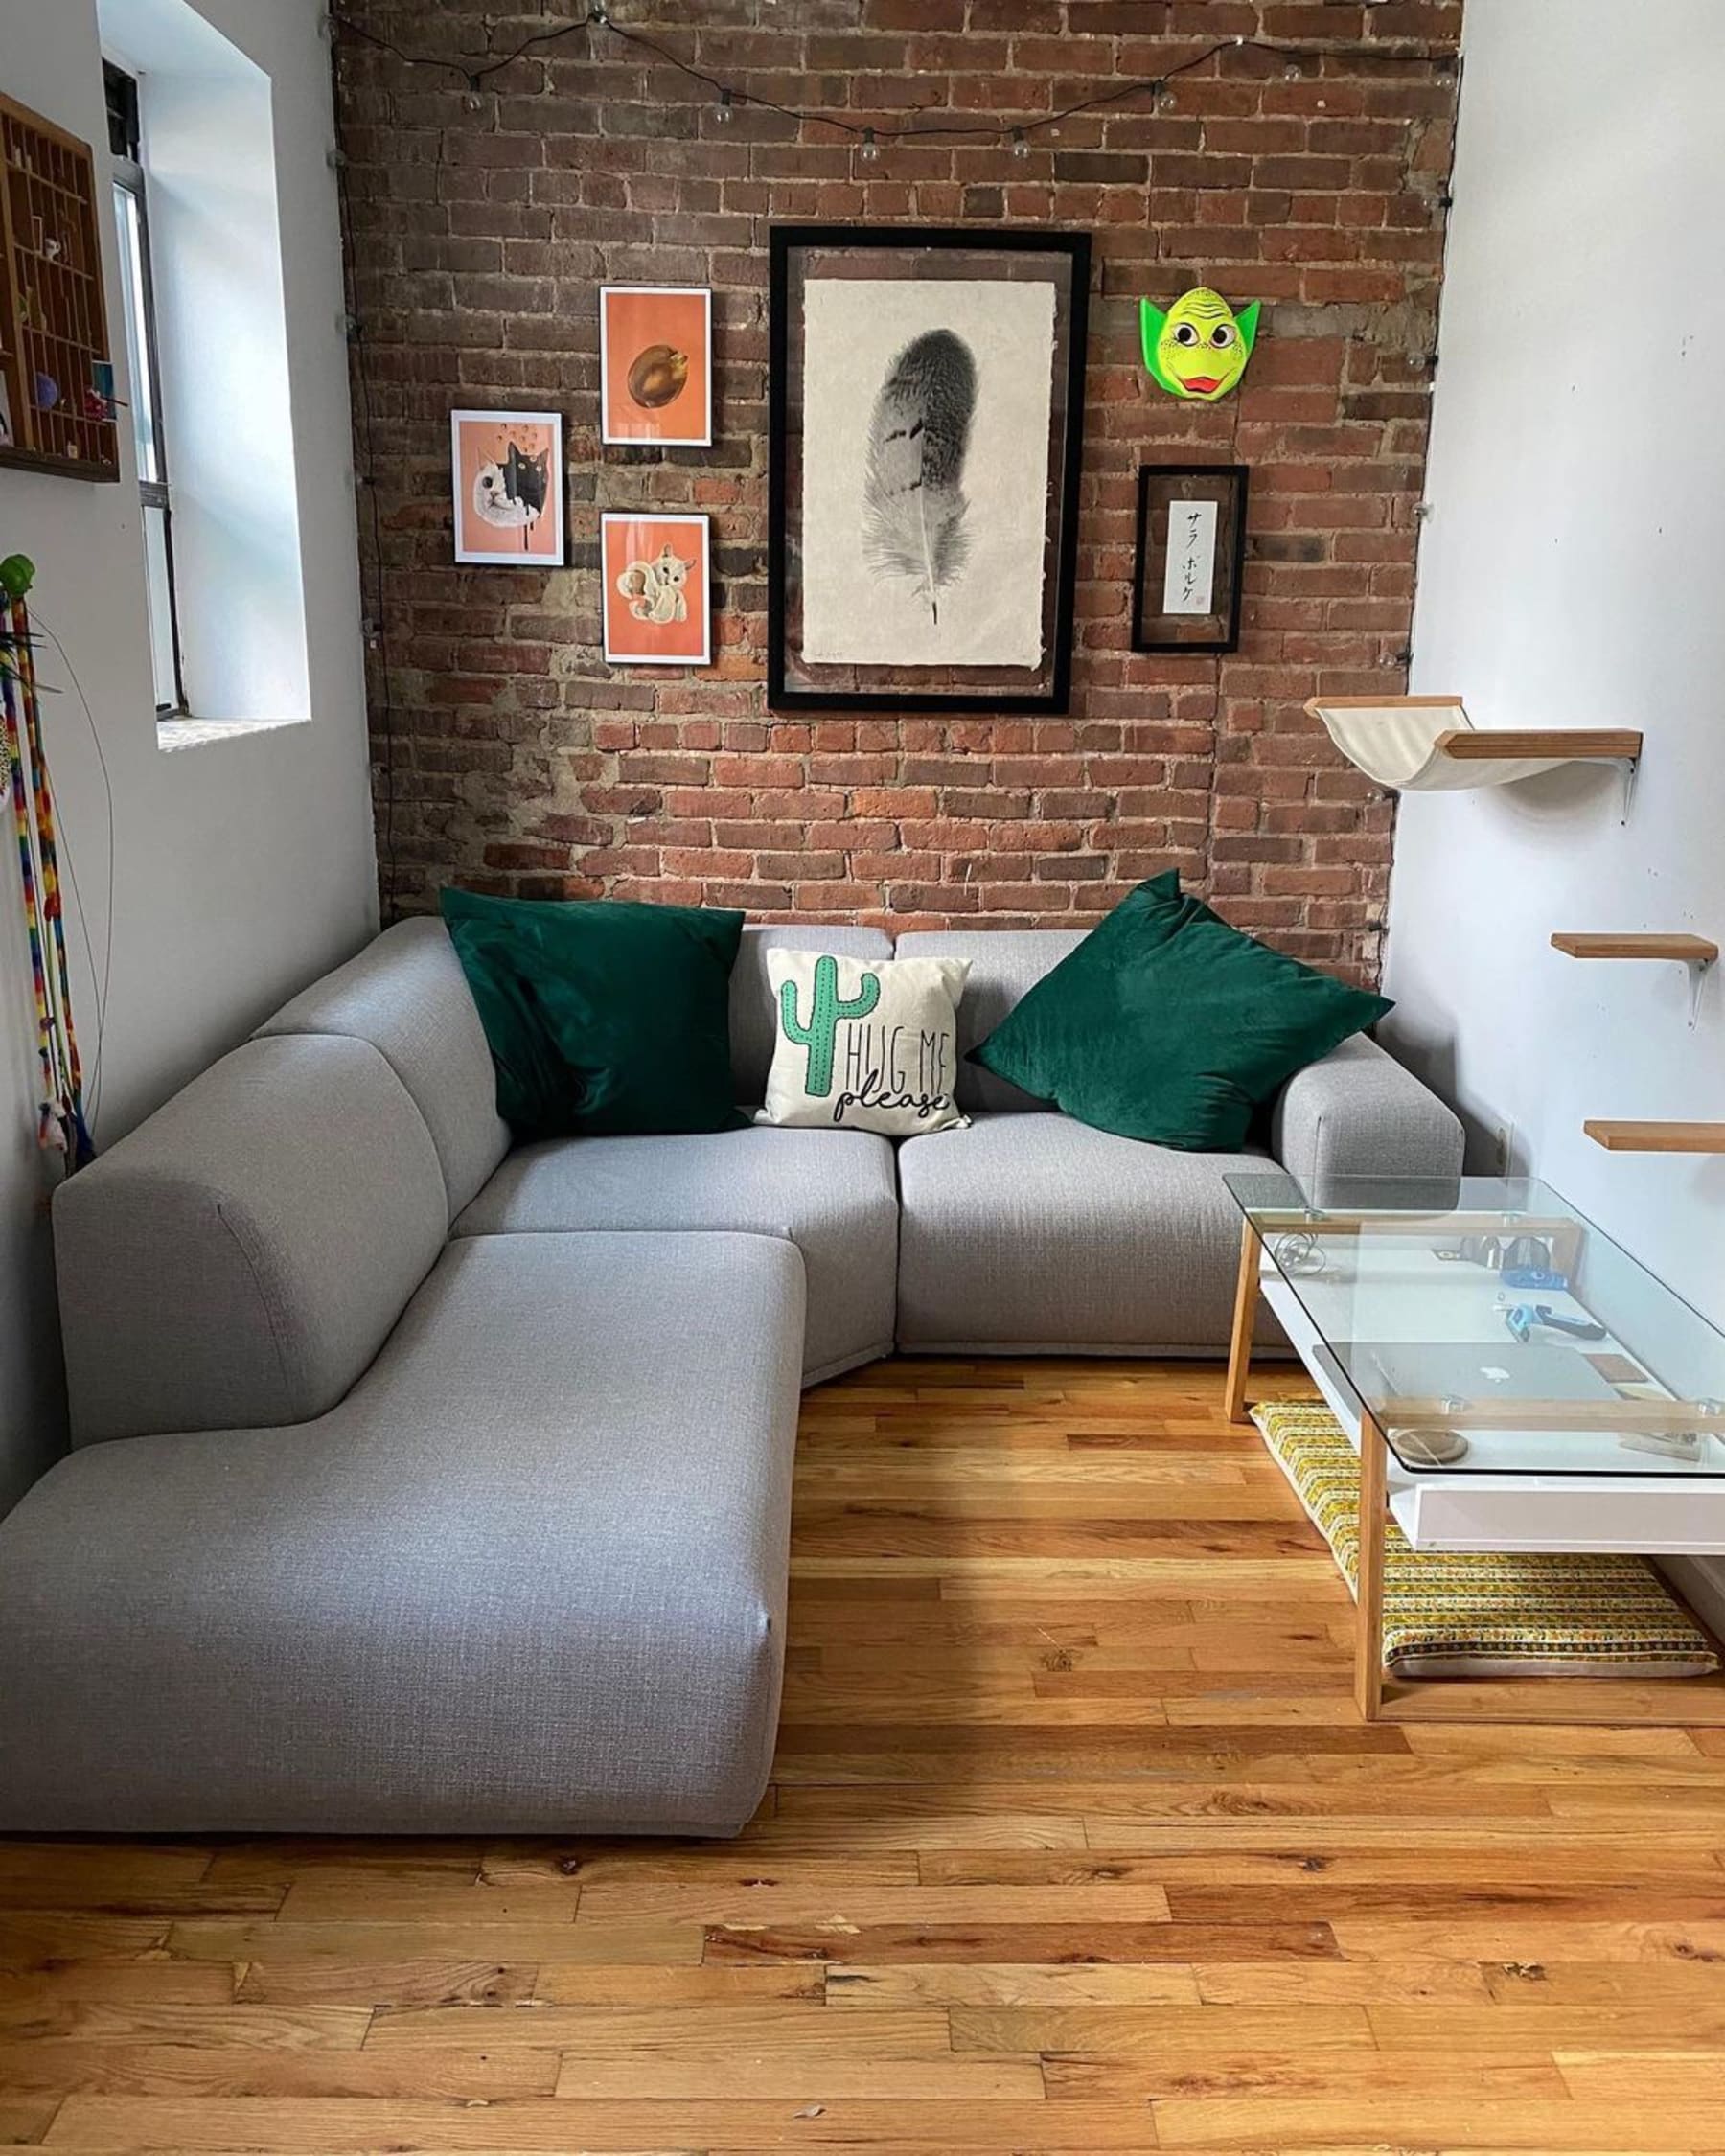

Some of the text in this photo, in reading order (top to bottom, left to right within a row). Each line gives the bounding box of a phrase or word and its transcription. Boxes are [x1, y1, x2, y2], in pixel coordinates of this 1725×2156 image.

[845, 1022, 950, 1096] HUG ME
[833, 1068, 951, 1122] please
